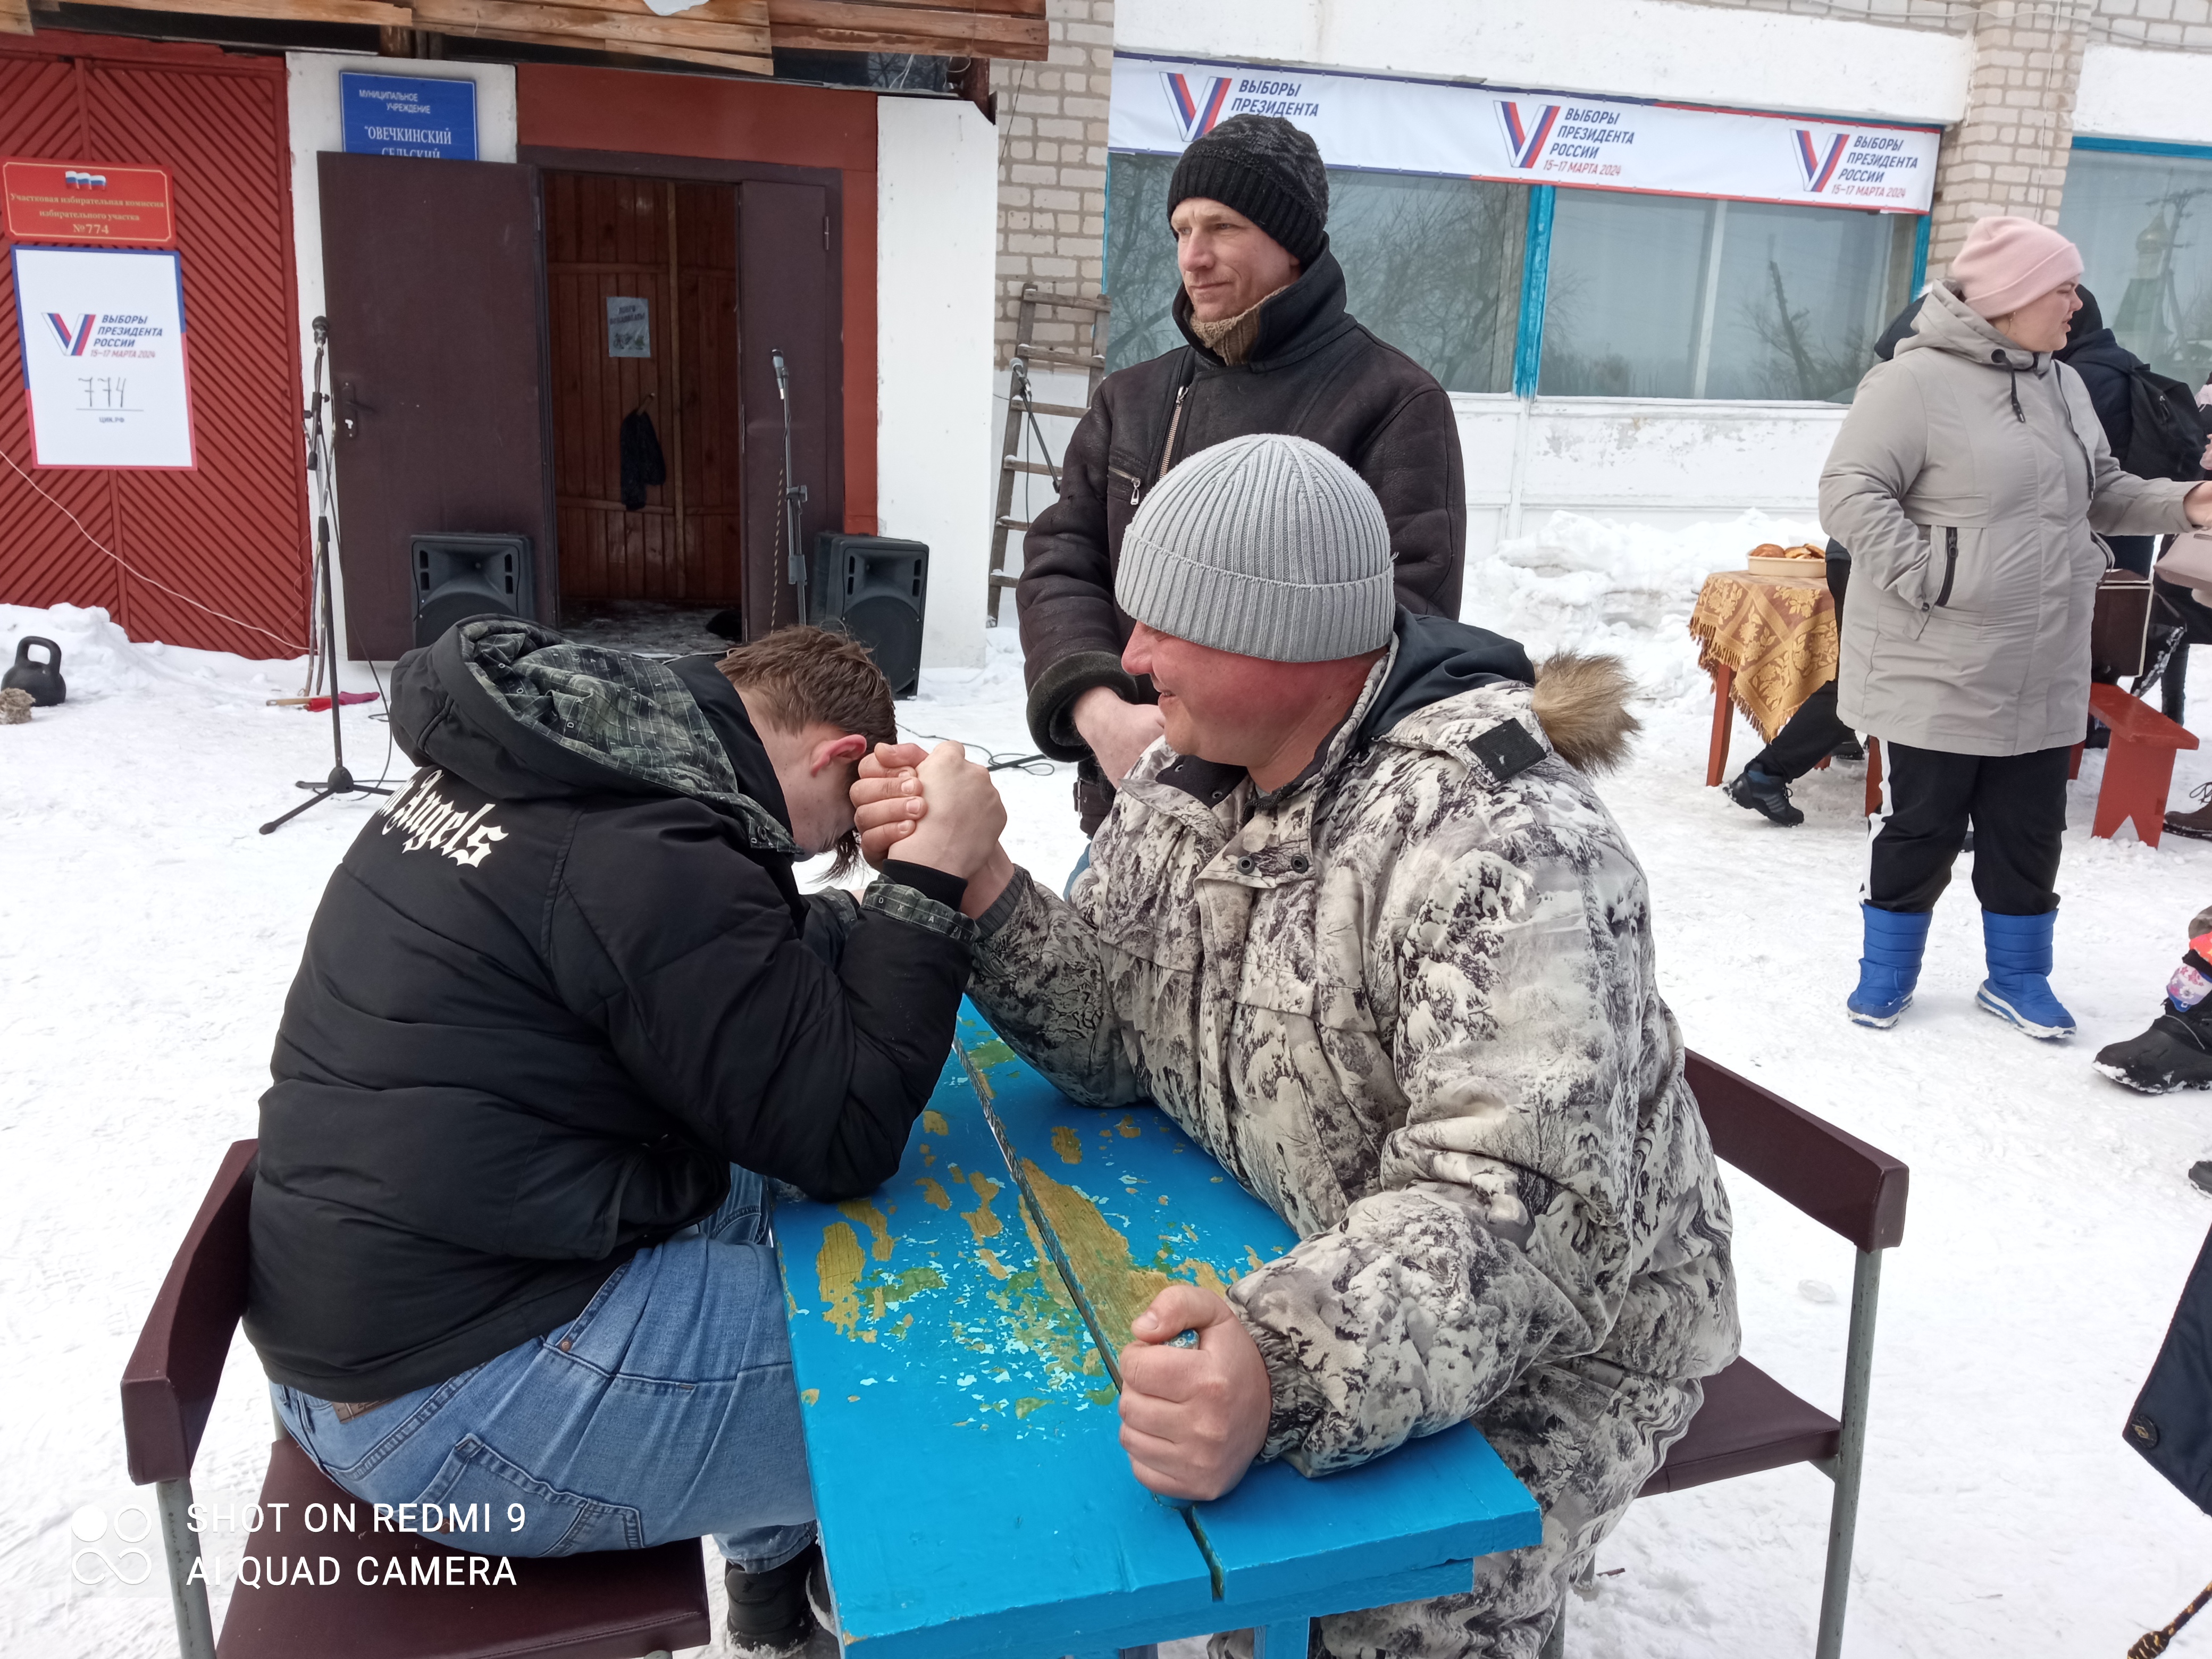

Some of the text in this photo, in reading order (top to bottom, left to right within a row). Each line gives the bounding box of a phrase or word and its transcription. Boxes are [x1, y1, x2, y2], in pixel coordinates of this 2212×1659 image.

[1239, 79, 1301, 97] ВЫБОРЫ
[359, 89, 418, 102] МУНИЦИПАЛЬНОЕ
[387, 103, 430, 113] УЧРЕЖДЕНИЕ
[1231, 97, 1319, 116] ПРЕЗИДЕНТА
[1564, 108, 1620, 124] ВЫБОРЫ
[1557, 125, 1635, 144] ПРЕЗИДЕНТА
[1854, 136, 1904, 150] ВЫБОРЫ
[1550, 143, 1599, 158] РОССИИ
[1847, 152, 1918, 169] ПРЕЗИДЕНТА
[1568, 163, 1597, 174] МАРТА
[1599, 165, 1621, 176] 2024
[1838, 169, 1884, 183] РОССИИ
[1856, 186, 1884, 197] МАРТА
[1886, 188, 1906, 198] 2024
[11, 193, 58, 204] Участковая
[61, 196, 123, 206] избирательная
[39, 210, 106, 220] избирательного
[73, 224, 109, 234] №774
[102, 315, 148, 324] ВЫБОРЫ
[97, 326, 163, 337] ПРЕЗИДЕНТА
[93, 339, 135, 347] РОССИИ
[78, 377, 127, 408] 774
